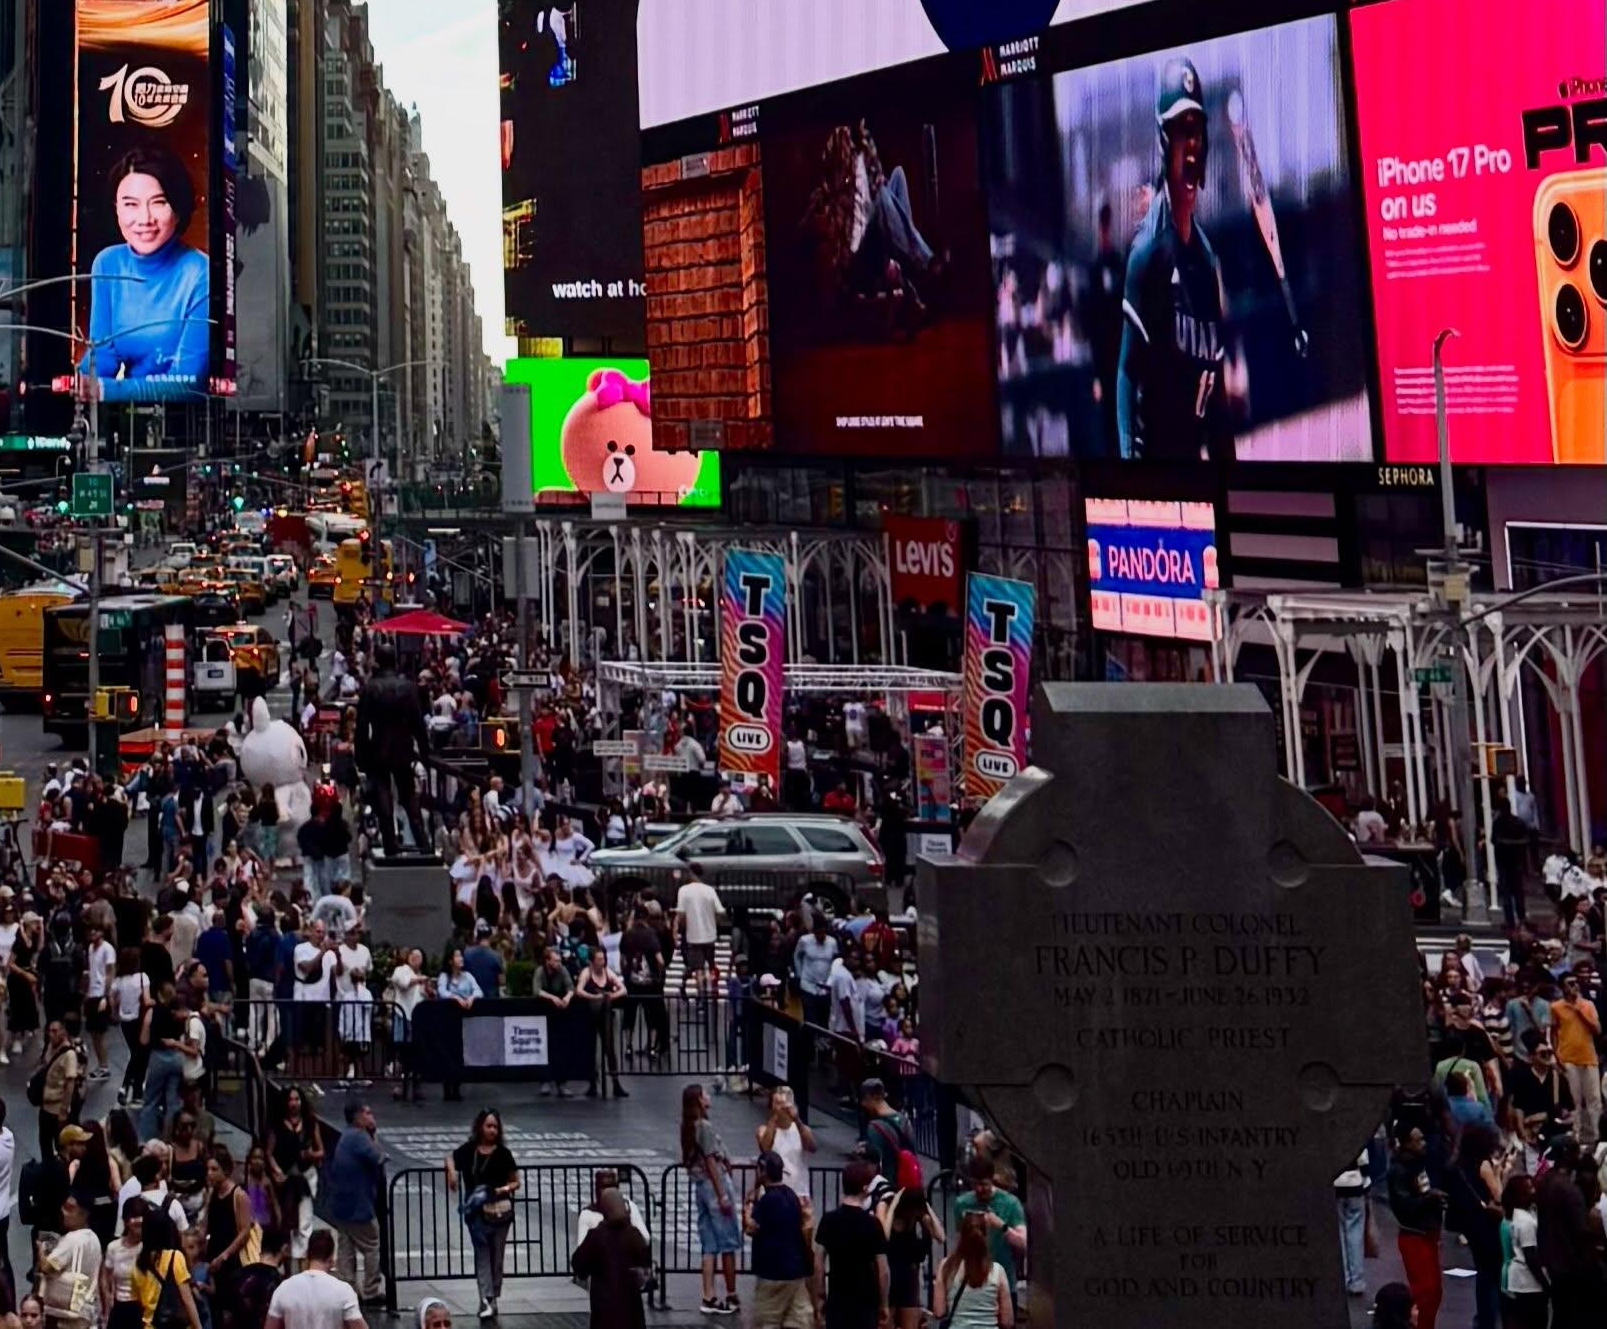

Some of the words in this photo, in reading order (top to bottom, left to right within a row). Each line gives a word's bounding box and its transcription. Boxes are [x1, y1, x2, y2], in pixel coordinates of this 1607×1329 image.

[999, 36, 1039, 58] MARRIOTT
[1000, 56, 1036, 76] MARQUIS
[1521, 97, 1607, 171] PR
[1377, 155, 1445, 188] iPhone
[1447, 147, 1470, 179] 17
[1473, 144, 1512, 175] Pro
[1381, 195, 1408, 221] on
[1411, 192, 1437, 217] us
[1383, 226, 1398, 241] No
[1398, 223, 1437, 239] trade-in
[1438, 218, 1478, 235] needed
[552, 279, 603, 298] watch
[607, 280, 623, 297] at
[1377, 467, 1435, 486] SEPHORA
[734, 573, 773, 722] TSQ
[980, 598, 1018, 751] TSQ
[736, 732, 762, 746] LIVE
[982, 757, 1010, 773] LIVE
[1052, 914, 1185, 935] LIEUTENANT
[1192, 914, 1302, 936] COLONEL
[1035, 946, 1168, 975] FRANCIS
[1214, 946, 1327, 975] DUFFY
[1054, 987, 1097, 1007] MAY
[1265, 987, 1310, 1007] 1932
[1077, 1028, 1190, 1049] CATHOLIC
[1208, 1028, 1291, 1048] PRIEST
[1131, 1090, 1244, 1111] CHAPLAIN
[1199, 1127, 1300, 1147] INFANTRY
[1114, 1161, 1158, 1180] OLD
[1118, 1226, 1162, 1247] LIFE
[1174, 1226, 1205, 1247] OF
[1215, 1226, 1308, 1247] SERVICE
[1180, 1254, 1218, 1270] FOR
[1085, 1278, 1138, 1297] GOD
[1149, 1278, 1198, 1297] AND
[1208, 1278, 1321, 1297] COUNTRY
